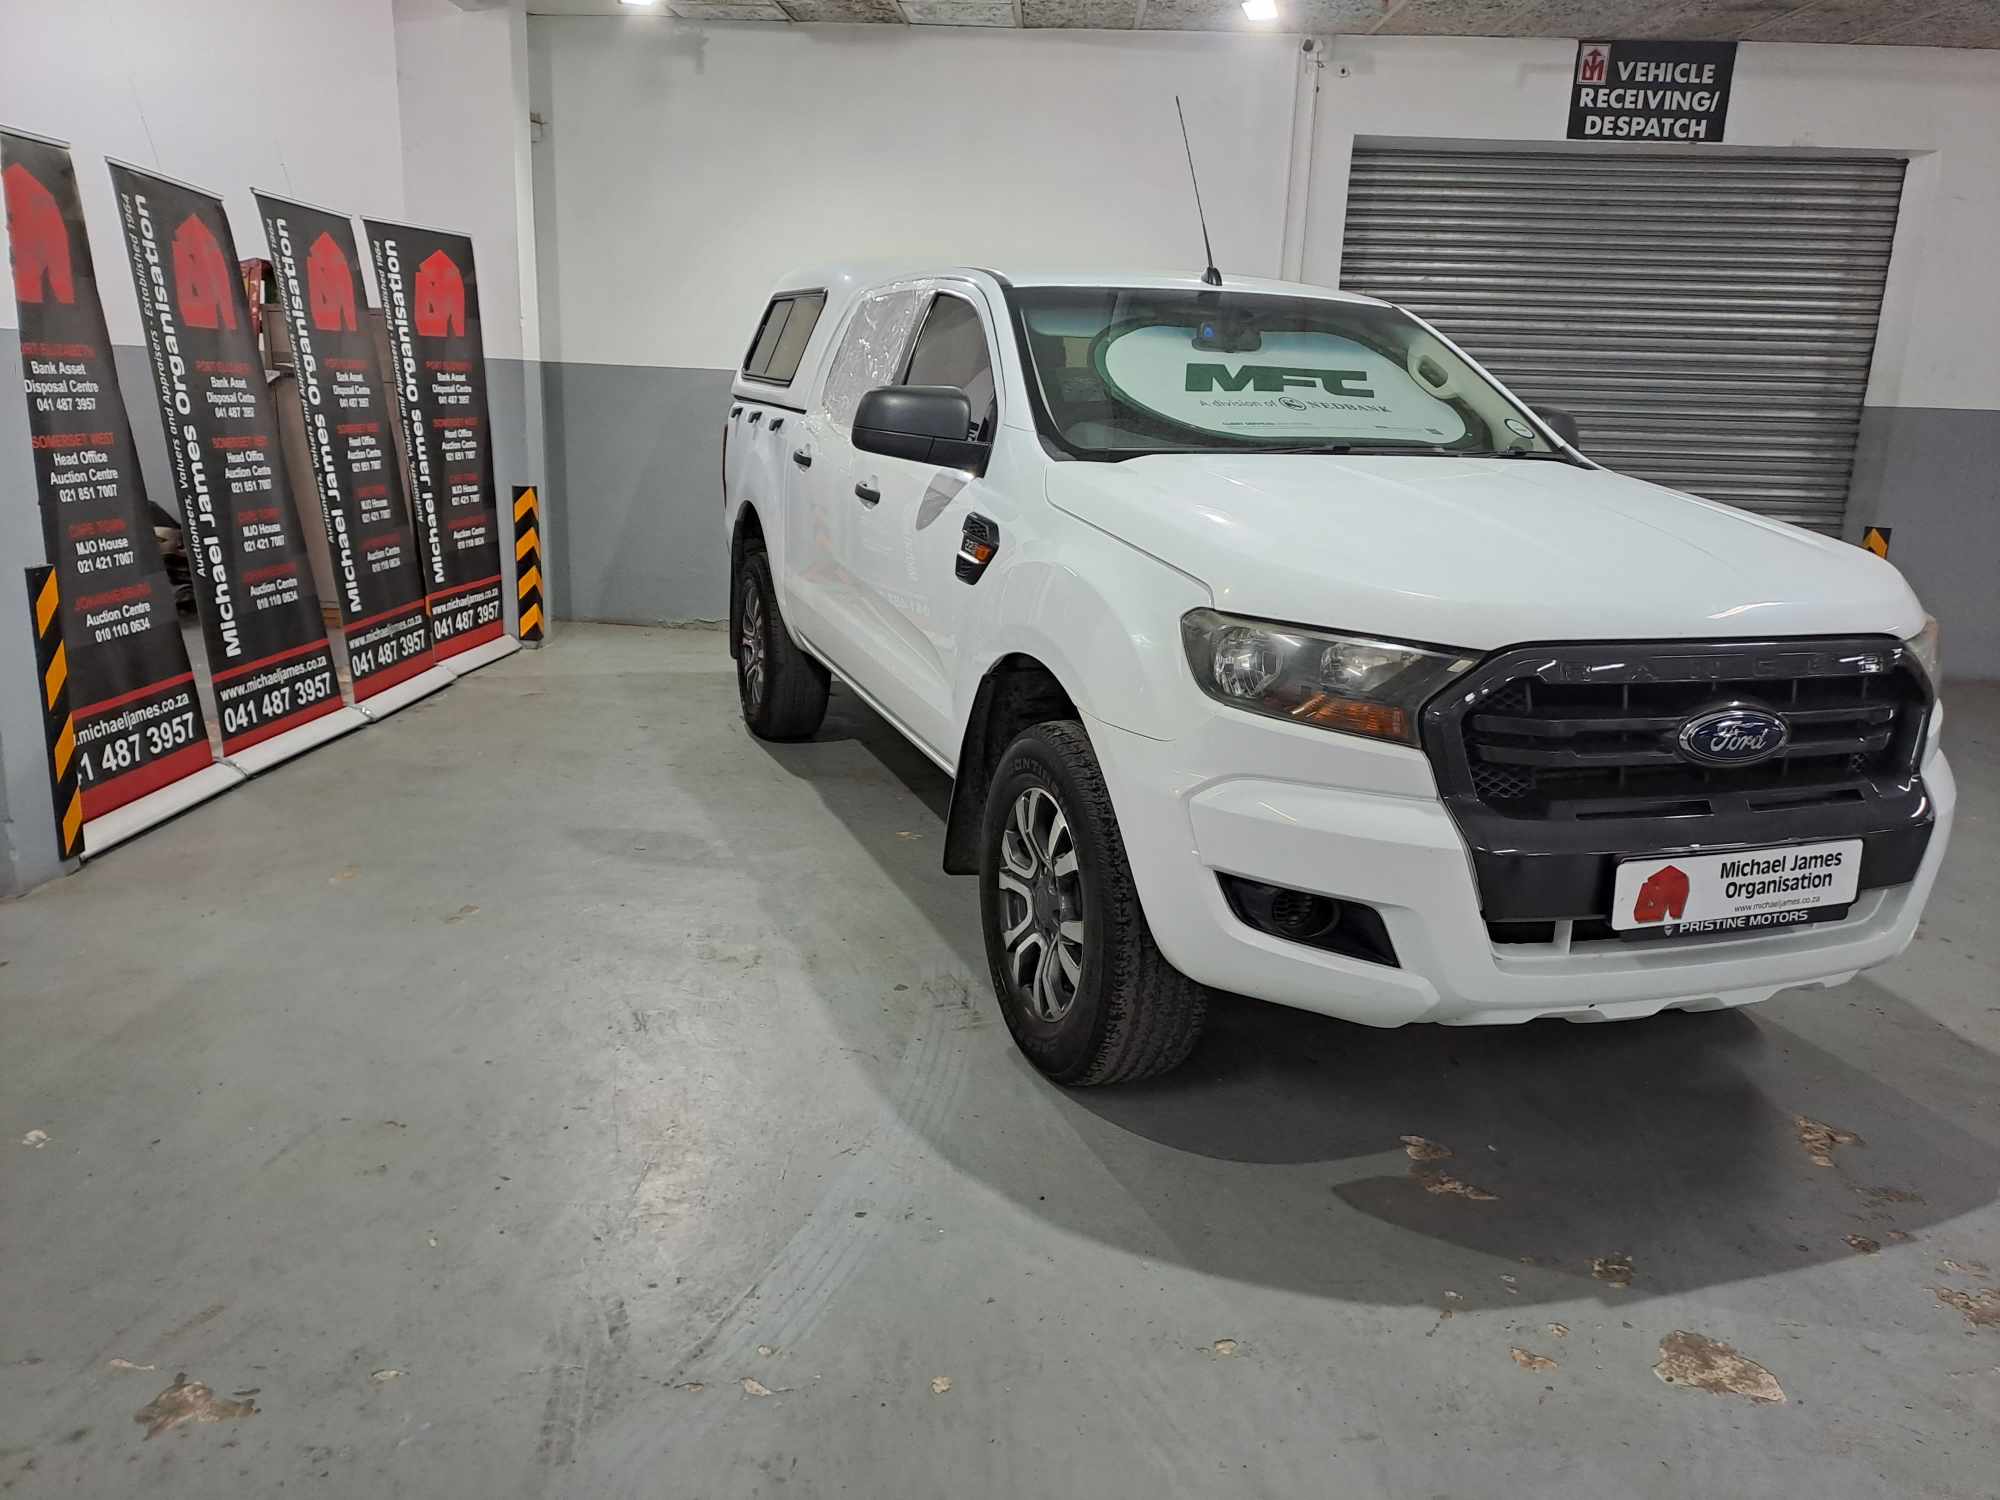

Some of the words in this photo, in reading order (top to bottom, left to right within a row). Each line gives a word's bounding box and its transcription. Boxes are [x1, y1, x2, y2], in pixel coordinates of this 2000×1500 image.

[1616, 61, 1716, 84] VEHICLE
[1579, 87, 1720, 113] RECEIVING/
[1584, 115, 1707, 139] DESPATCH
[121, 193, 136, 229] 1964
[129, 234, 153, 317] Established
[135, 194, 191, 415] Organisation
[276, 218, 321, 406] Organisation
[385, 239, 419, 402] Organisation
[31, 361, 57, 375] Bank
[59, 361, 86, 375] Asset
[150, 330, 173, 406] Appraisers
[1185, 362, 1375, 398] MFC
[24, 379, 67, 396] Disposal
[69, 381, 99, 393] Centre
[206, 391, 236, 405] Disposal
[36, 398, 54, 411] 041
[56, 398, 73, 410] 487
[75, 397, 96, 410] 3957
[1307, 400, 1393, 414] NEDBANK
[165, 406, 178, 435] and
[53, 453, 78, 466] Head
[80, 450, 108, 464] Office
[314, 414, 341, 501] James
[411, 409, 431, 486] James
[50, 471, 88, 485] Auction
[89, 468, 118, 481] Centre
[172, 438, 189, 489] Valuers
[183, 425, 216, 527] James
[225, 467, 250, 479] Auction
[59, 488, 76, 502] 021
[79, 486, 95, 500] 851
[98, 484, 117, 498] 7007
[76, 540, 97, 555] MJO
[100, 537, 129, 551] House
[184, 494, 206, 577] Auctioneers,
[422, 492, 445, 583] Michael
[77, 560, 94, 574] 021
[95, 556, 112, 570] 421
[114, 551, 134, 566] 7007
[331, 509, 362, 613] Michael
[203, 536, 242, 658] Michael
[250, 582, 276, 596] Auction
[86, 610, 123, 627] Auction
[122, 602, 151, 618] Centre
[434, 618, 454, 640] 041
[455, 610, 474, 632] 487
[477, 601, 500, 624] 3957
[95, 628, 112, 643] 010
[112, 622, 129, 637] 110
[352, 649, 376, 677] 041
[377, 640, 398, 667] 487
[399, 629, 425, 656] 3957
[220, 655, 327, 701] www.michaeljames.co.za
[224, 699, 257, 733] 041
[262, 686, 290, 718] 487
[294, 671, 331, 705] 3957
[74, 692, 189, 746] .michaeljames.co.za
[101, 733, 141, 772] 487
[147, 711, 195, 754] 3957
[1710, 721, 1769, 752] Ford
[1720, 855, 1787, 879] Michael
[1789, 852, 1843, 872] James
[1725, 872, 1833, 899] Organisation
[1679, 917, 1746, 933] PRISTINE
[1749, 910, 1808, 927] MOTORS
